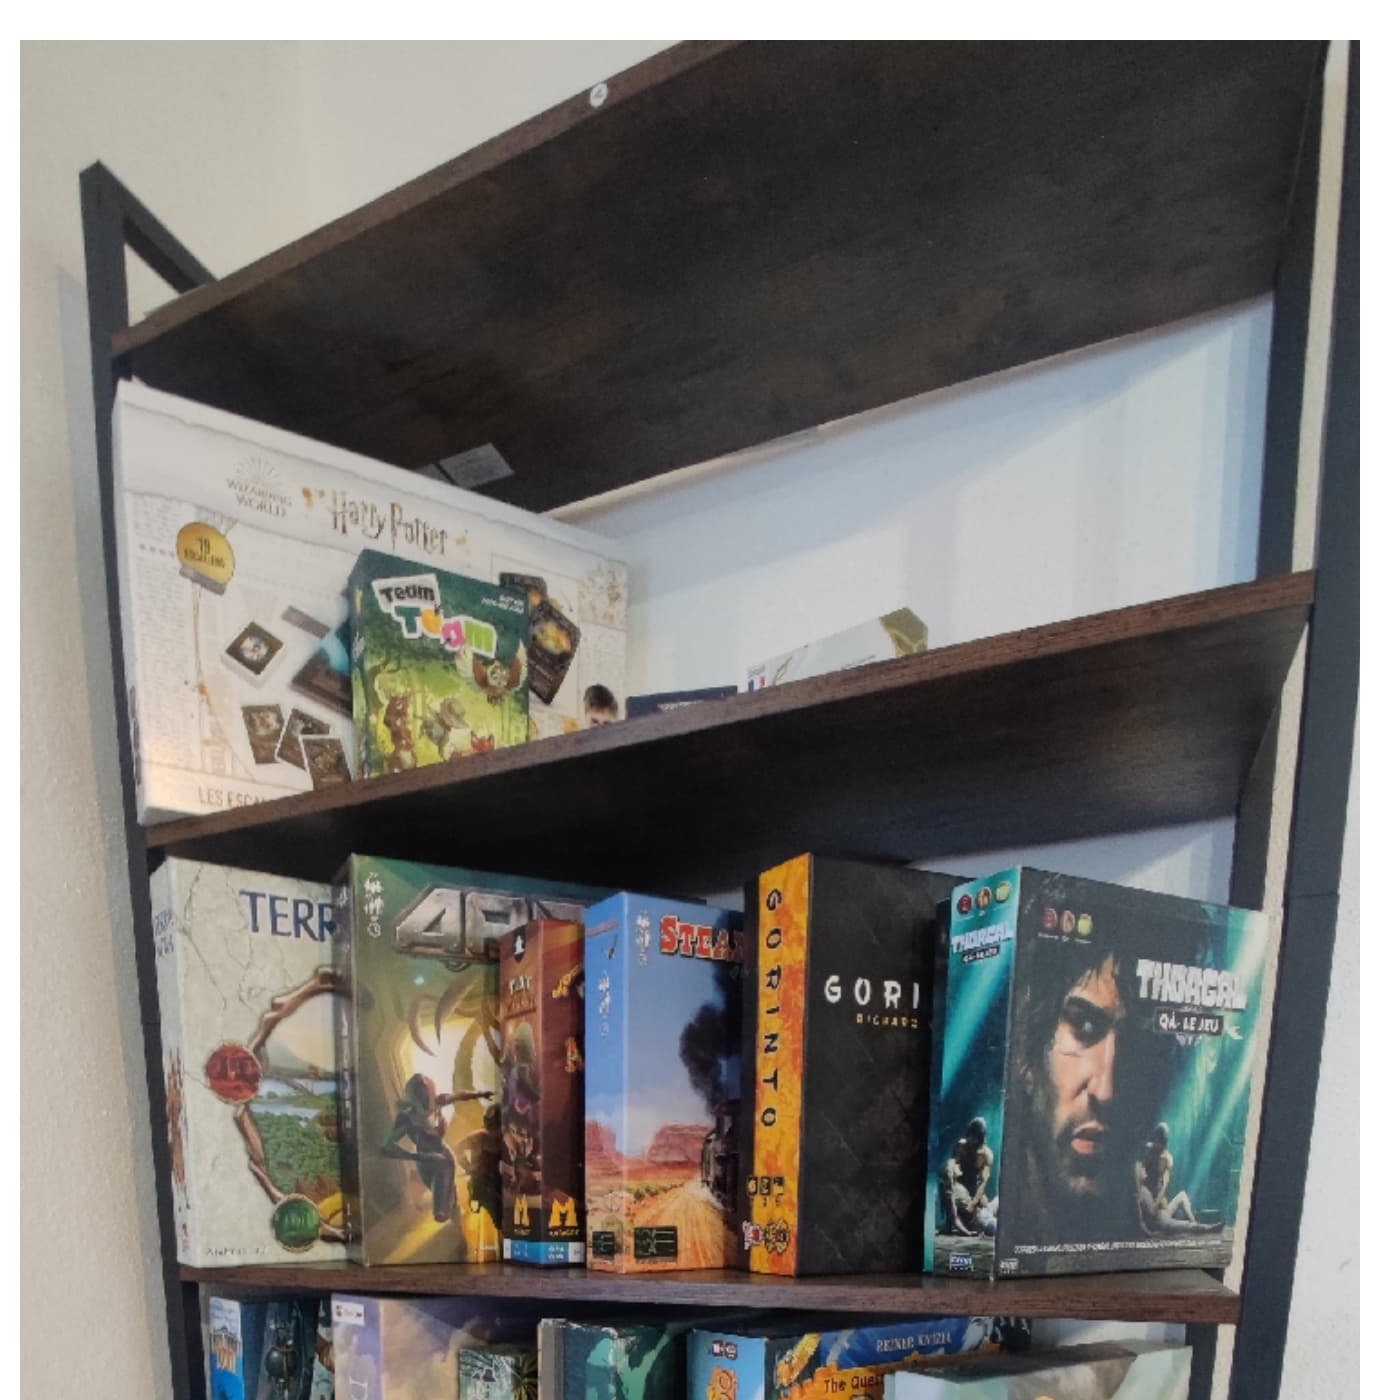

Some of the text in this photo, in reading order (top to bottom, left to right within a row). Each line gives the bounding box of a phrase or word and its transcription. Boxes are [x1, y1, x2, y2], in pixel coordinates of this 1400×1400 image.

[330, 491, 448, 555] Harry Potter
[379, 585, 436, 603] Team
[760, 888, 784, 1128] GORINTO
[823, 974, 921, 1011] GORI
[824, 1378, 846, 1394] The
